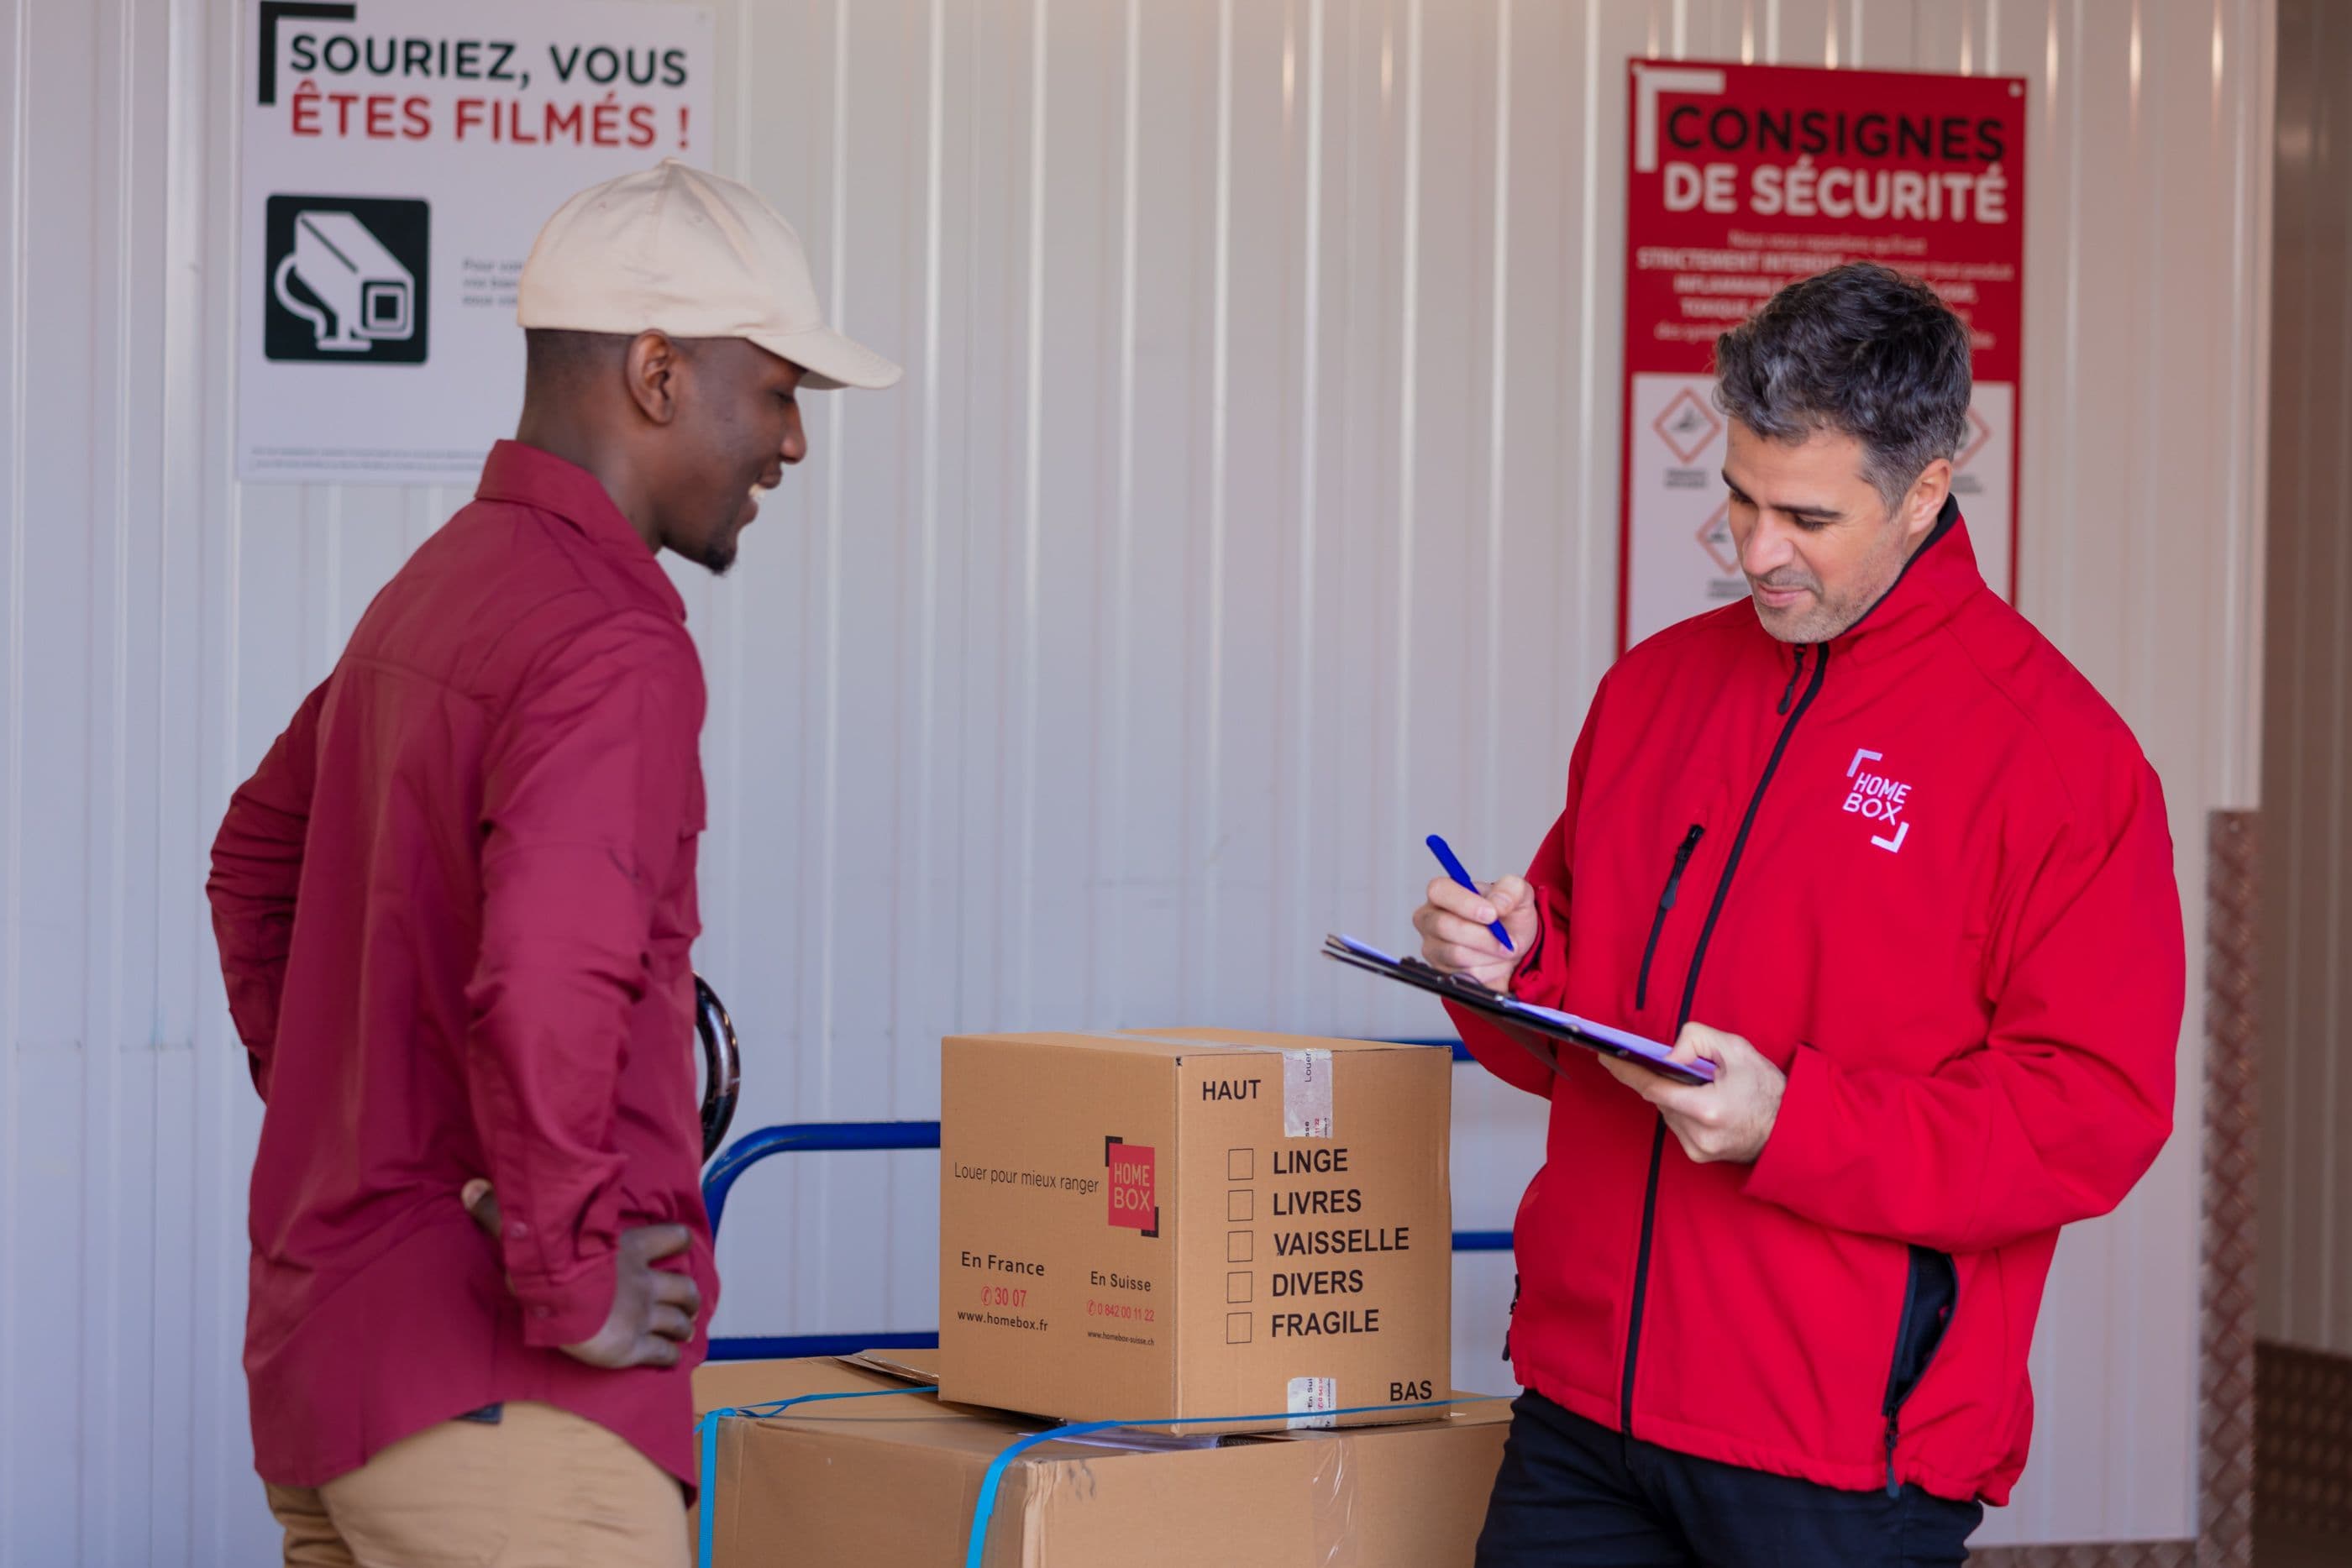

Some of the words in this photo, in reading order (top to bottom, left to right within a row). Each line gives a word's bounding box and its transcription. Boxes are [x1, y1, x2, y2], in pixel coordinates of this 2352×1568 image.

[291, 34, 531, 91] SOURIEZ,
[549, 44, 688, 87] VOUS
[291, 79, 433, 140] ÊTES
[455, 90, 657, 148] FILMÉS
[677, 107, 690, 149] !
[1667, 104, 2005, 162] CONSIGNES
[1663, 162, 1738, 212] DE
[1750, 153, 2008, 224] SÉCURITÉ
[1852, 772, 1912, 804] HOME
[1842, 792, 1903, 826] BOX
[1202, 1079, 1262, 1101] HAUT
[1273, 1148, 1348, 1174] LINGE
[954, 1162, 987, 1180] Louer
[990, 1168, 1017, 1184] pour
[1021, 1170, 1057, 1188] mieux
[1060, 1177, 1099, 1195] ranger
[1114, 1162, 1150, 1188] HOME
[1114, 1187, 1150, 1212] BOX
[1273, 1189, 1362, 1216] LIVRES
[1273, 1227, 1410, 1256] VAISSELLE
[961, 1251, 981, 1268] En
[988, 1254, 1044, 1276] France
[1090, 1271, 1105, 1286] En
[1110, 1273, 1151, 1292] Suisse
[1272, 1269, 1364, 1297] DIVERS
[995, 1287, 1008, 1306] 30
[1012, 1289, 1026, 1308] 07
[958, 1311, 1048, 1331] www.homebox.fr
[1097, 1303, 1103, 1315] 0
[1105, 1303, 1120, 1318] 842
[1121, 1306, 1131, 1319] 00
[1134, 1308, 1142, 1320] 11
[1144, 1309, 1155, 1322] 22
[1272, 1308, 1379, 1337] FRAGILE
[1390, 1380, 1433, 1402] BAS
